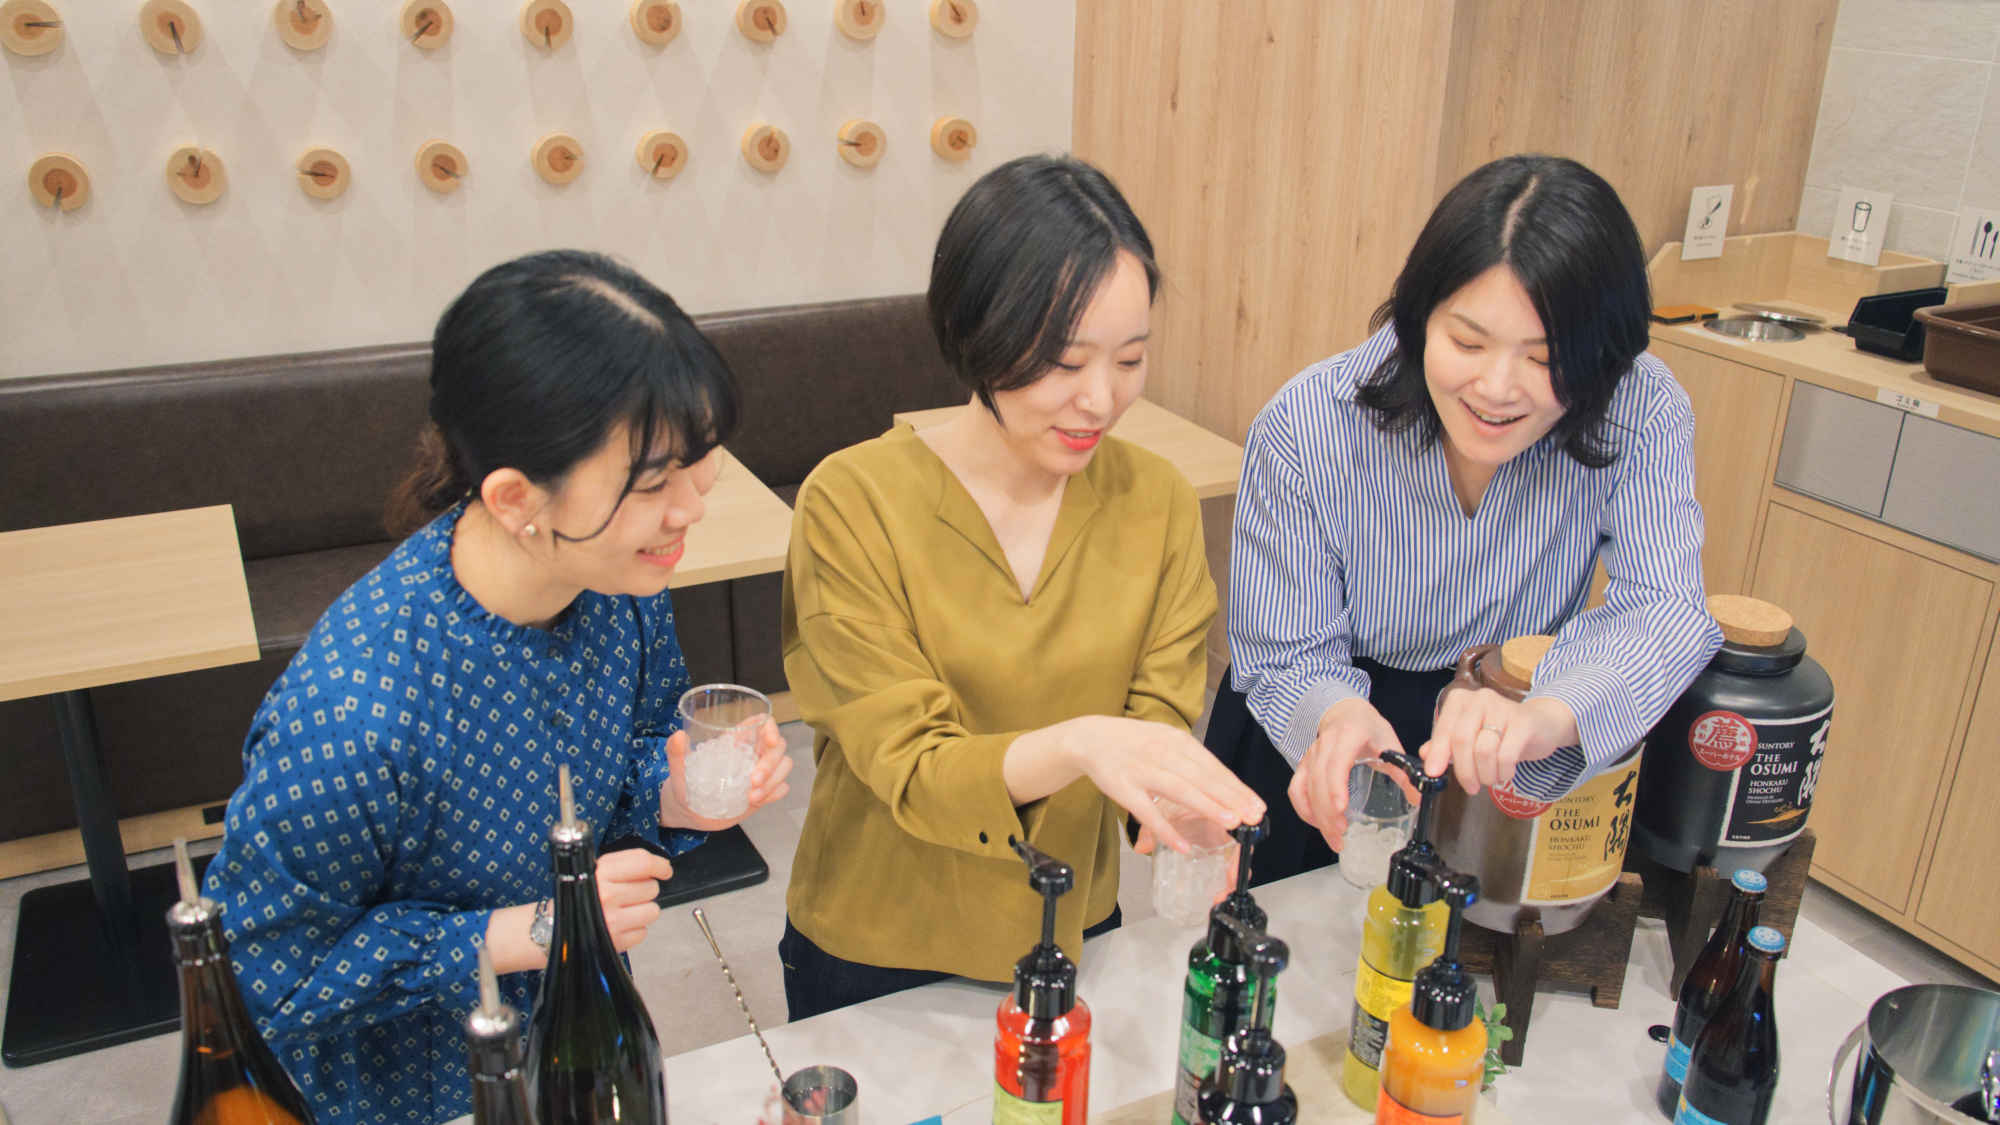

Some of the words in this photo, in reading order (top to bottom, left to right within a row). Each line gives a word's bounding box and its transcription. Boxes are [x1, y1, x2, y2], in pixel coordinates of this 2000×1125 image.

[1896, 394, 1921, 408] ゴミ箱
[1757, 742, 1795, 750] SUNTORY
[1699, 748, 1741, 761] スーパーホテル
[1756, 753, 1781, 763] THE
[1750, 760, 1799, 776] OSUMI
[1750, 779, 1789, 787] HONKAKU
[1498, 794, 1542, 808] スーパーホテル
[1554, 808, 1581, 817] THE
[1550, 816, 1601, 831] OSUMI
[1550, 835, 1592, 843] HONKAKU
[1548, 843, 1585, 851] SHOCHU
